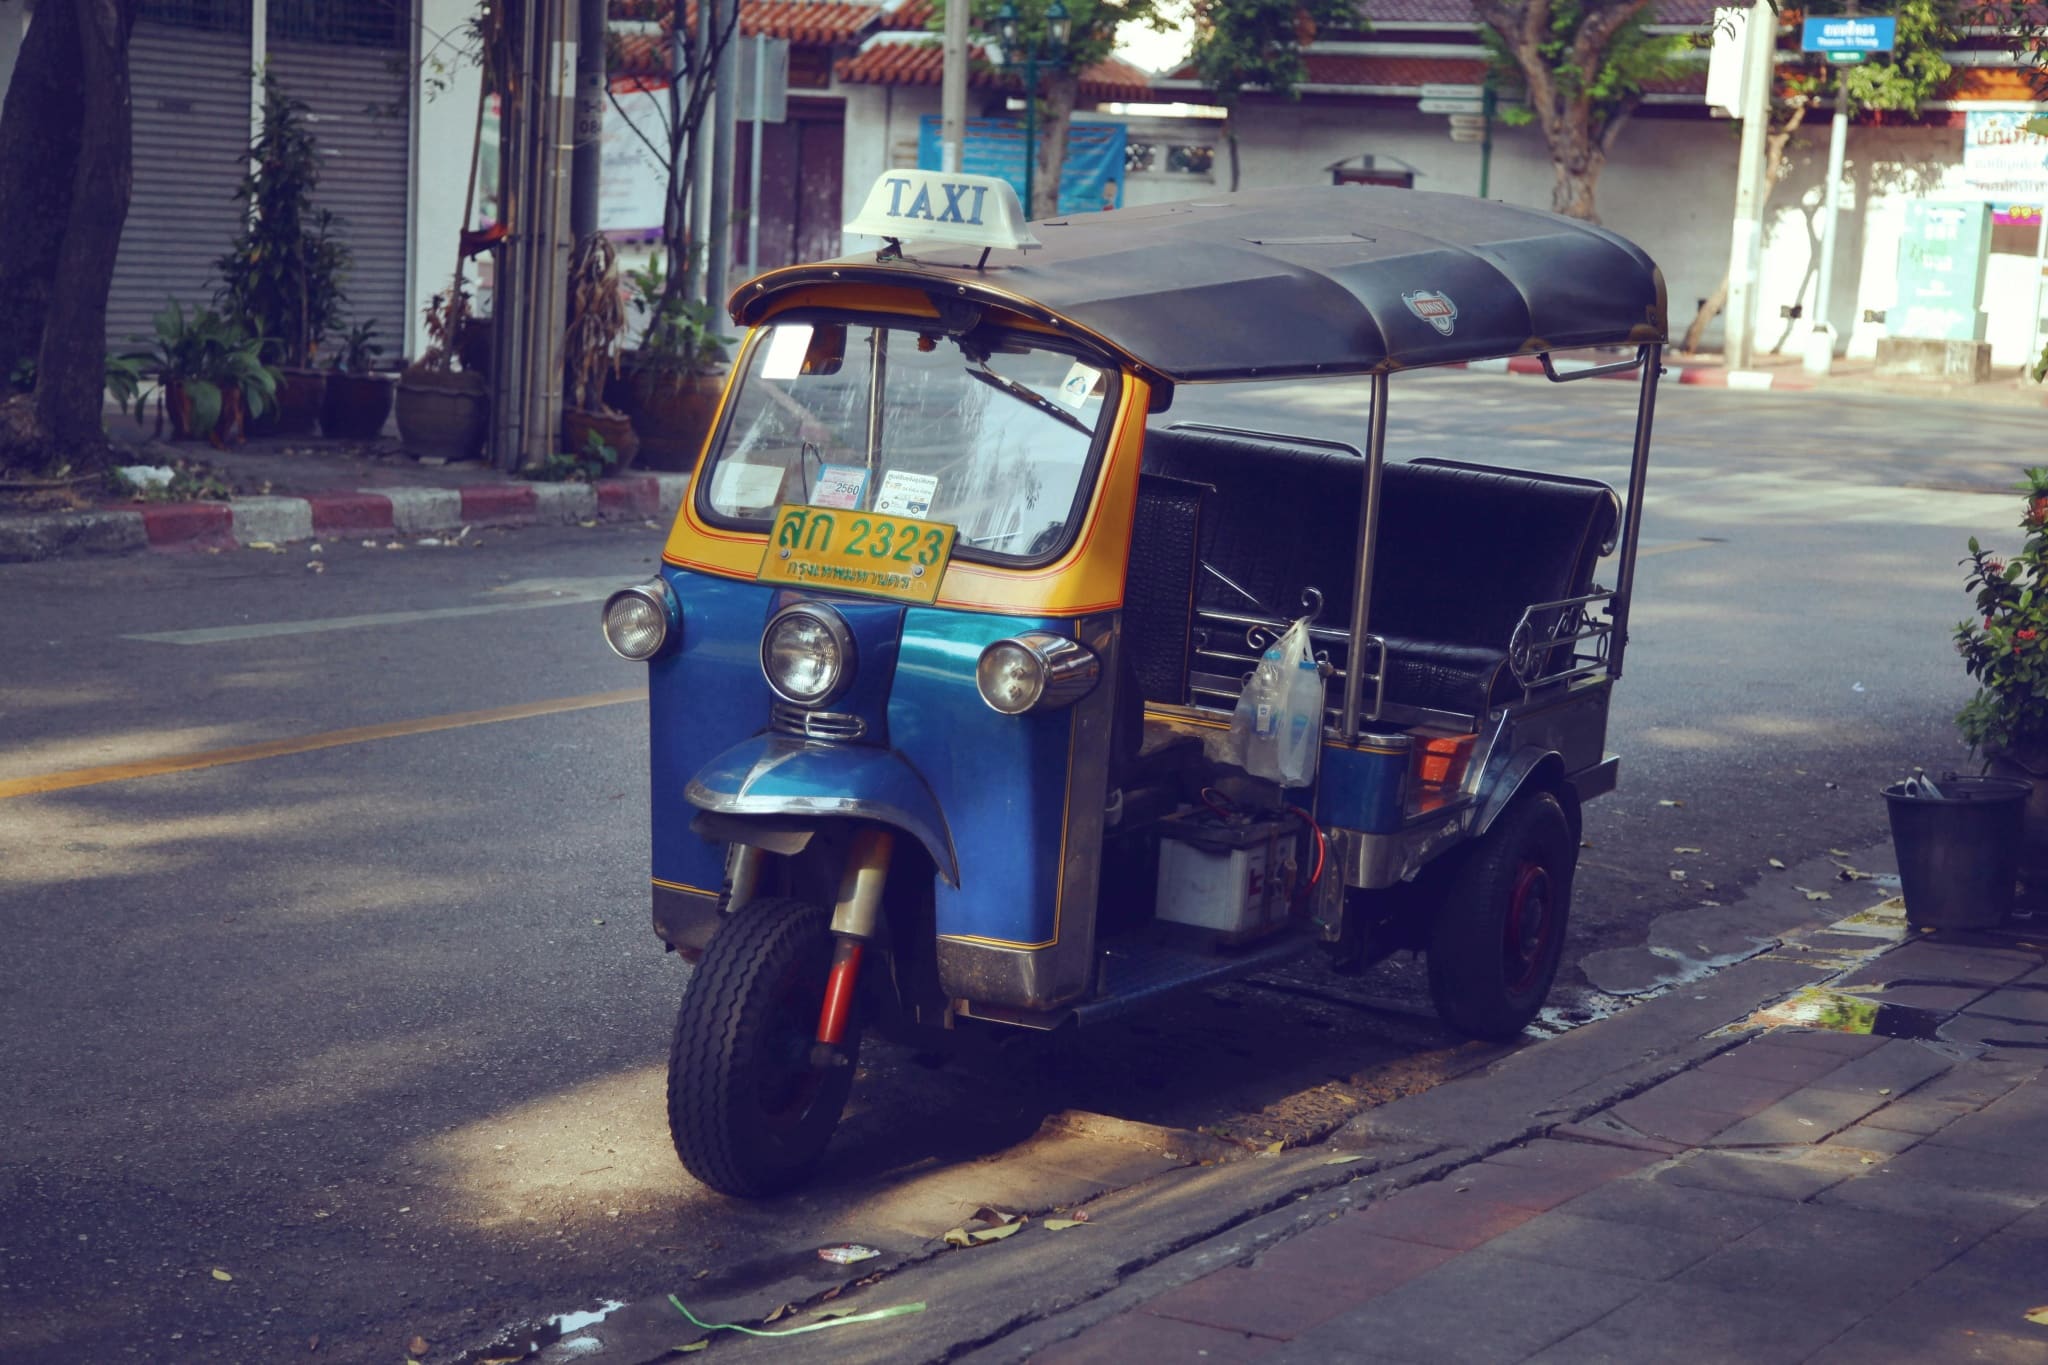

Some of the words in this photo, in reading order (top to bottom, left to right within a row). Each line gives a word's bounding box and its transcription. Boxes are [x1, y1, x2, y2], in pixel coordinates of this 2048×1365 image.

[885, 178, 989, 226] TAXI
[835, 482, 860, 496] 2560
[778, 510, 835, 552] สก
[844, 518, 945, 567] 2323
[786, 560, 913, 590] กรุงเทพมหานคร
